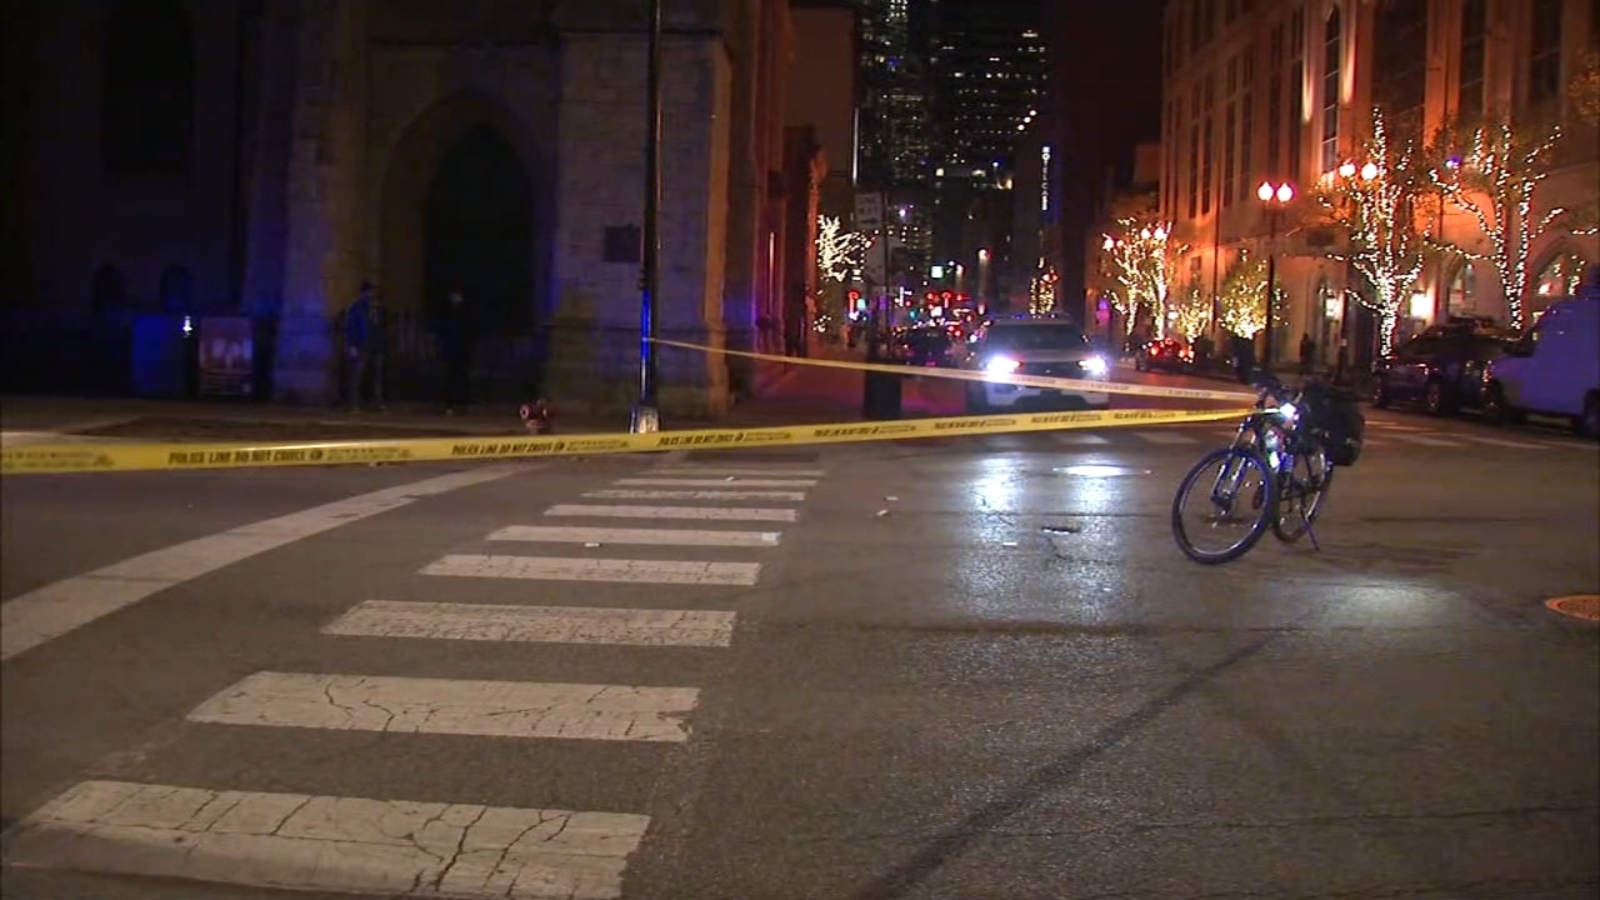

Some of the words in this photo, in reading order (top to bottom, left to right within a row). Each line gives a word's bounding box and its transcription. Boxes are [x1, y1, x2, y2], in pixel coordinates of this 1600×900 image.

[168, 450, 205, 464] POLICE
[208, 449, 232, 463] LINE
[234, 449, 250, 462] DO
[251, 449, 271, 461] NOT
